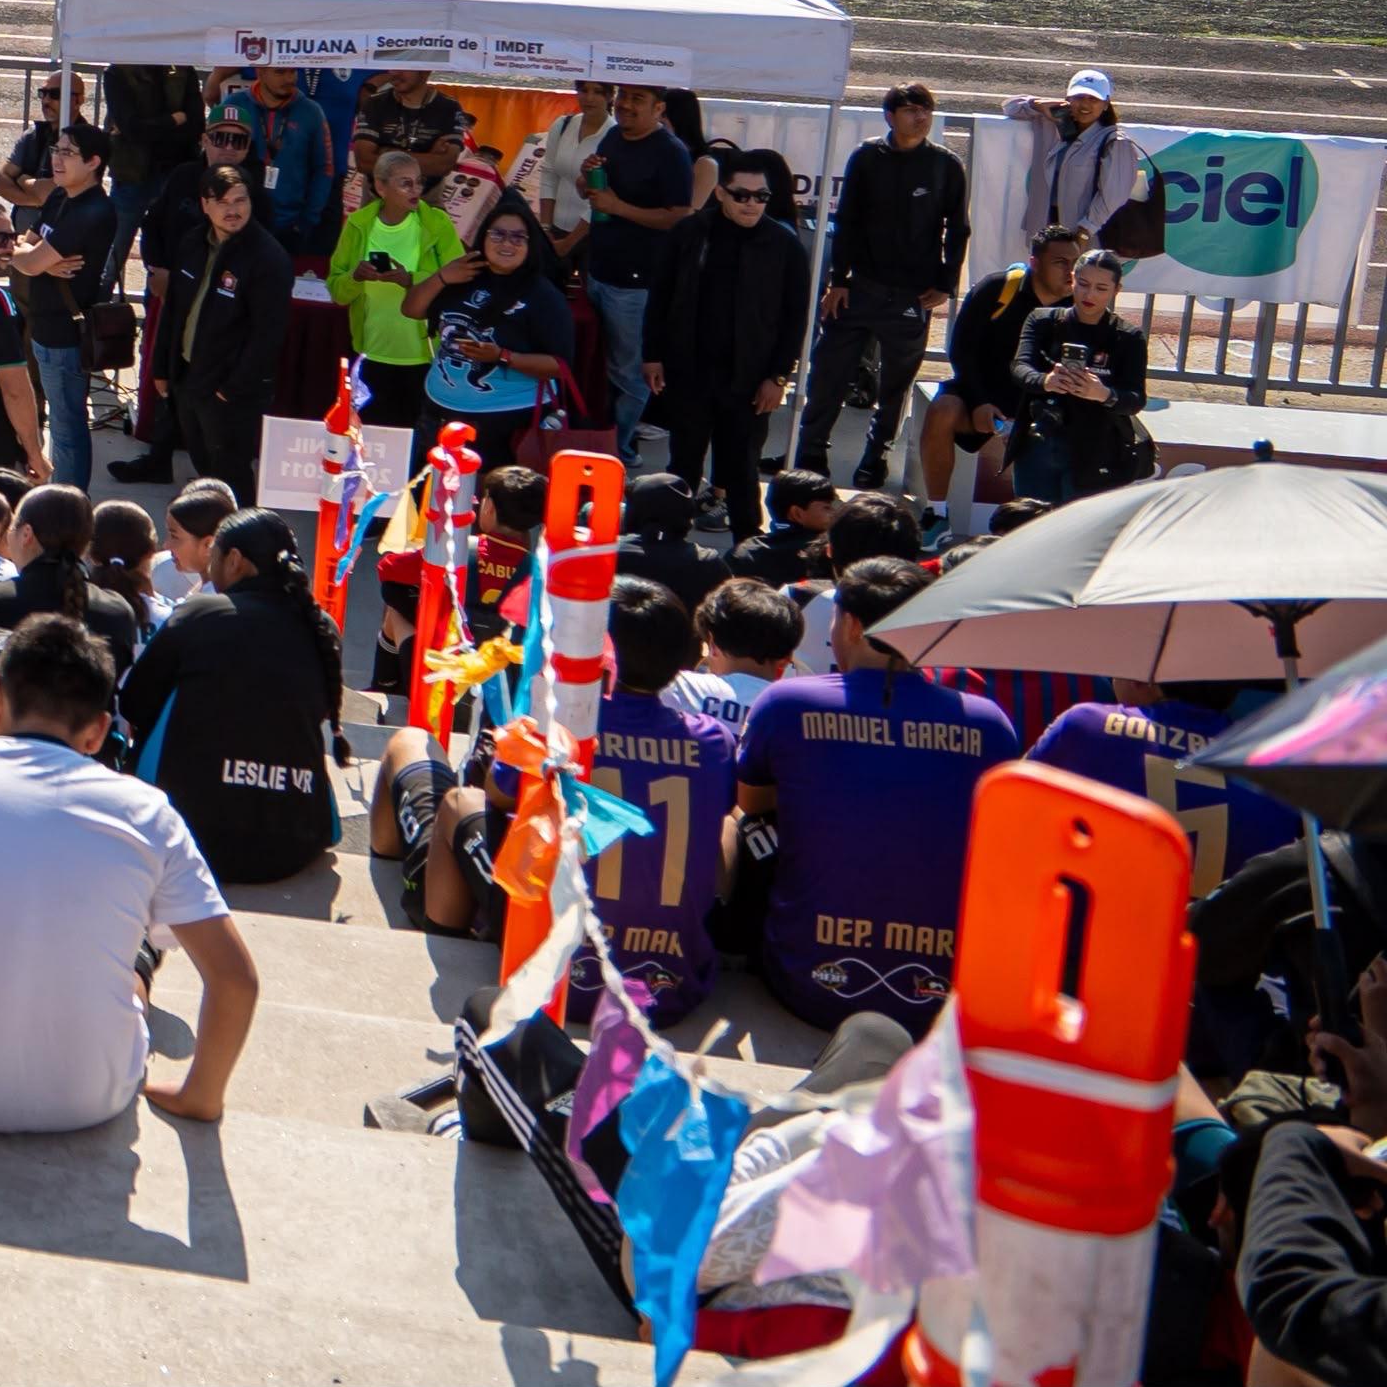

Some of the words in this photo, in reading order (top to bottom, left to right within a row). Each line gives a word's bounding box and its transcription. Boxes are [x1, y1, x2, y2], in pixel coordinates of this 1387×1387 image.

[277, 39, 357, 54] TIJUANA
[377, 35, 453, 48] Secretaría
[458, 39, 478, 50] de
[495, 40, 544, 54] IMDET
[1163, 156, 1304, 228] ciel
[597, 731, 700, 768] RIQUE
[801, 711, 895, 746] MANUEL
[903, 720, 983, 758] GARCIA
[1104, 712, 1212, 753] GONZA
[223, 759, 286, 791] LESLIE
[291, 767, 314, 794] VR
[591, 766, 690, 907] 11
[623, 926, 684, 959] MAR
[885, 921, 956, 958] MAR
